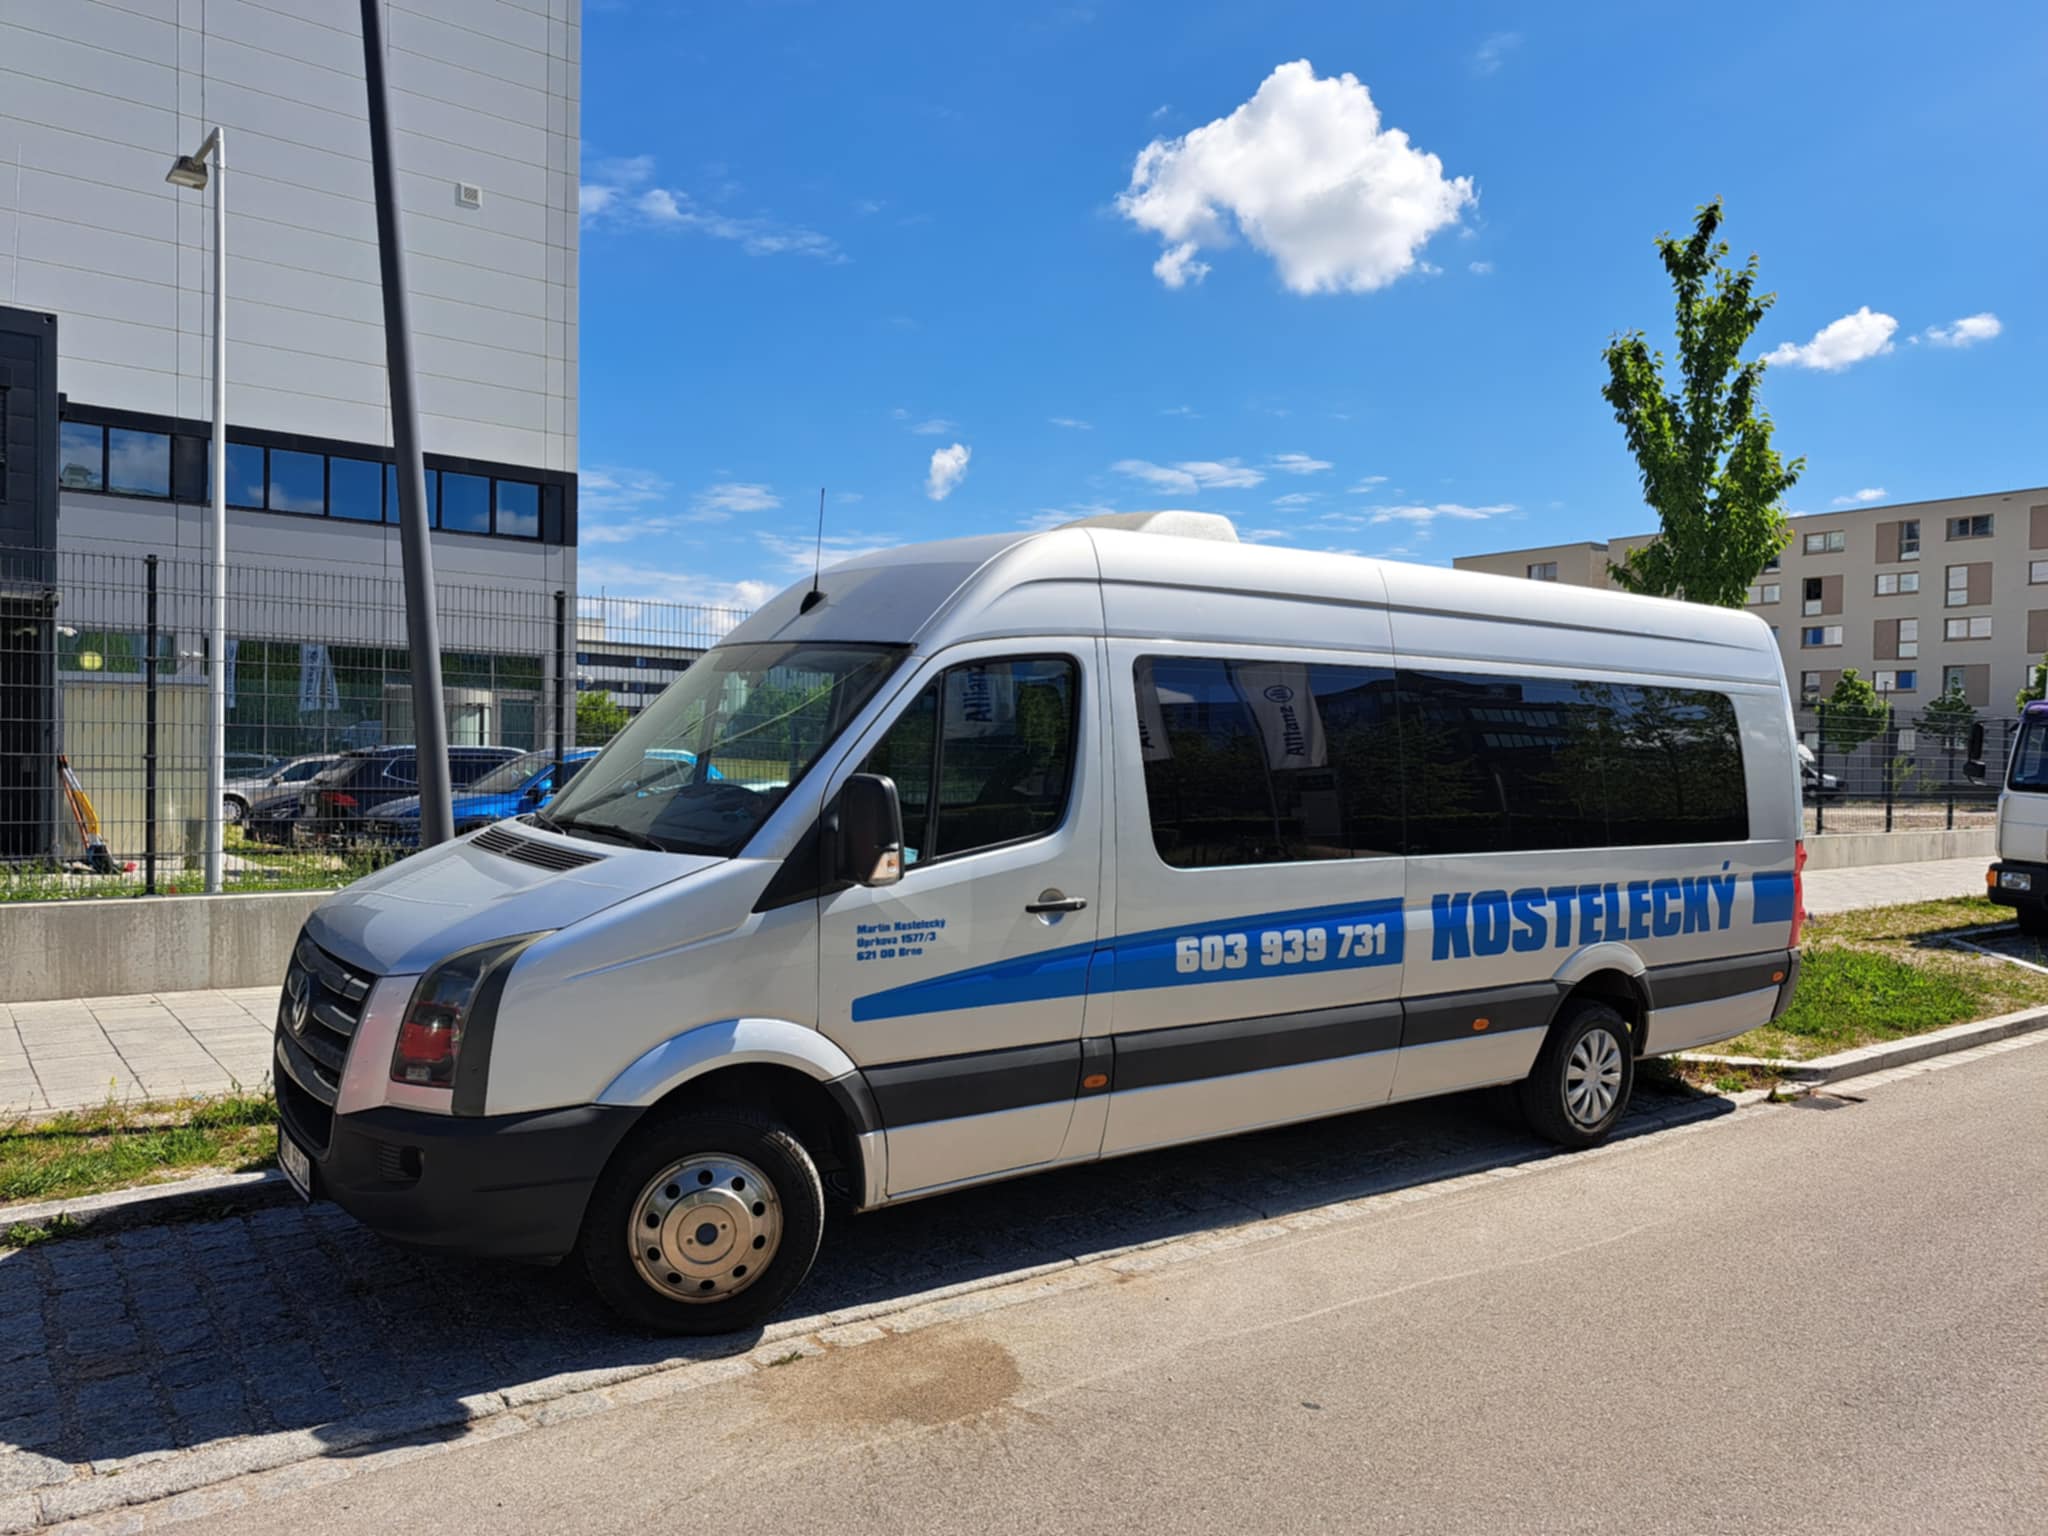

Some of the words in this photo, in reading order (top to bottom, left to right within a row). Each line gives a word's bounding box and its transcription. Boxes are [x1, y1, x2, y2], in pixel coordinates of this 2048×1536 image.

[1279, 705, 1305, 756] Allianz
[1432, 860, 1737, 961] KOSTELECKÝ
[857, 925, 890, 934] Martin
[901, 932, 936, 943] 1577/3
[857, 951, 876, 960] 621
[880, 949, 895, 958] 00
[1176, 934, 1248, 974] 603
[1260, 927, 1327, 967] 939
[1337, 922, 1386, 959] 731
